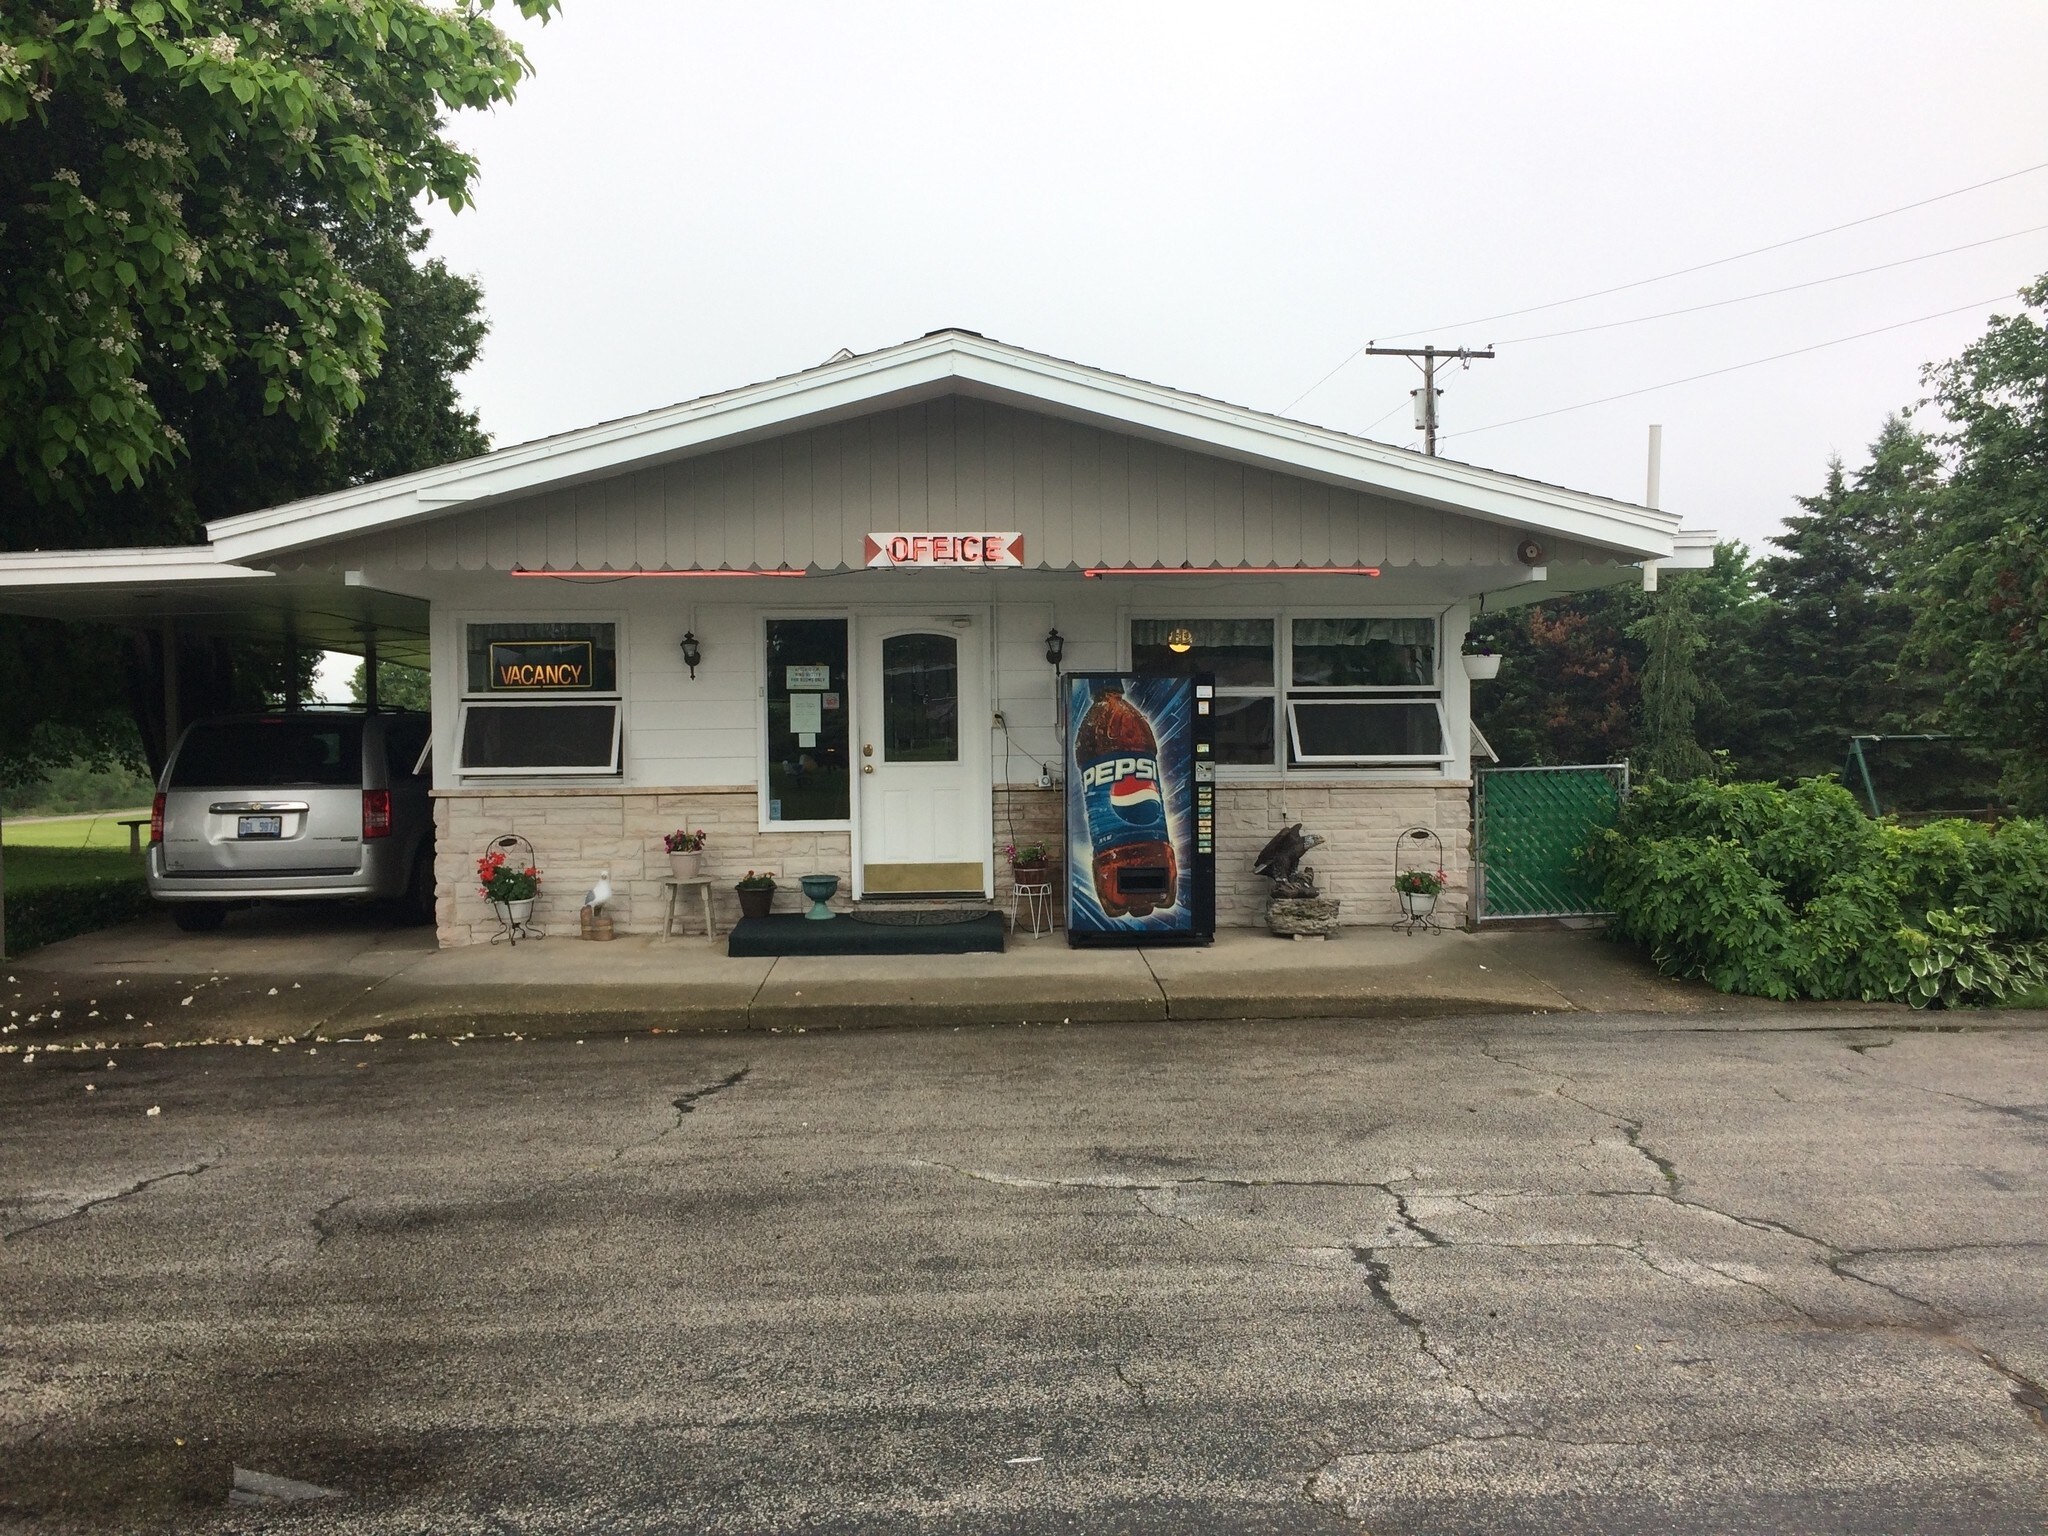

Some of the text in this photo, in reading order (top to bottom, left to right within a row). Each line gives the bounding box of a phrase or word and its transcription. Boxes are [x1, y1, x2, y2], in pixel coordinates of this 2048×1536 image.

[889, 536, 1004, 562] OFFICE
[500, 664, 582, 685] VACANCY
[1083, 757, 1157, 793] PEPSI
